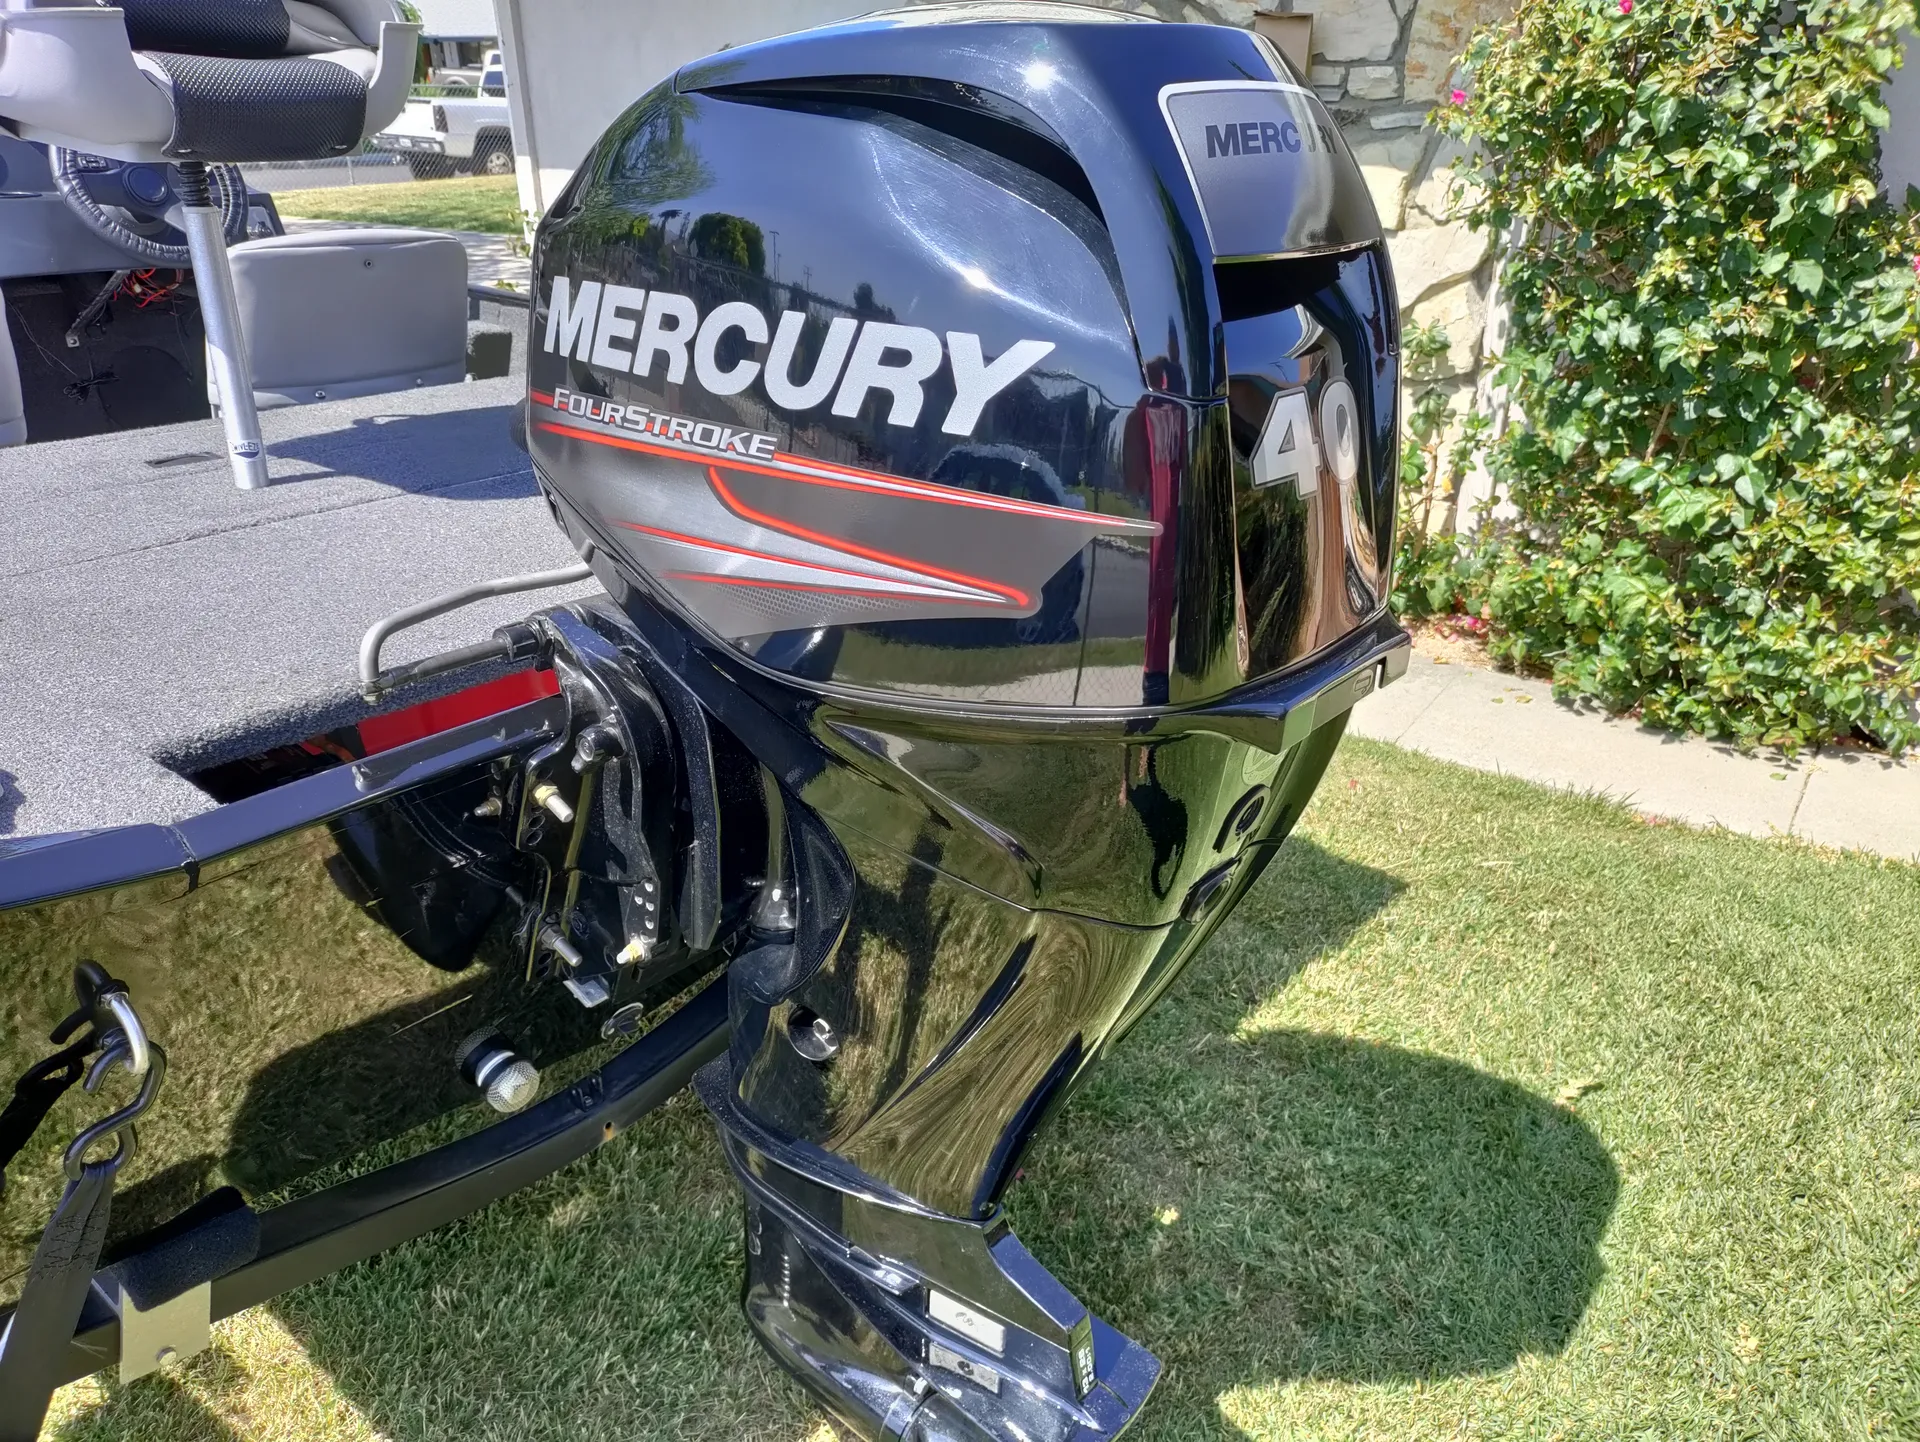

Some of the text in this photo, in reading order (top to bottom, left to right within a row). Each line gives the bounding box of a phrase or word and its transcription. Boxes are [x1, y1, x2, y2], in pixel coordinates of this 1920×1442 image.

[543, 275, 1056, 436] MERCURY
[553, 387, 778, 459] FOURSTROKE
[1250, 376, 1360, 500] 40
